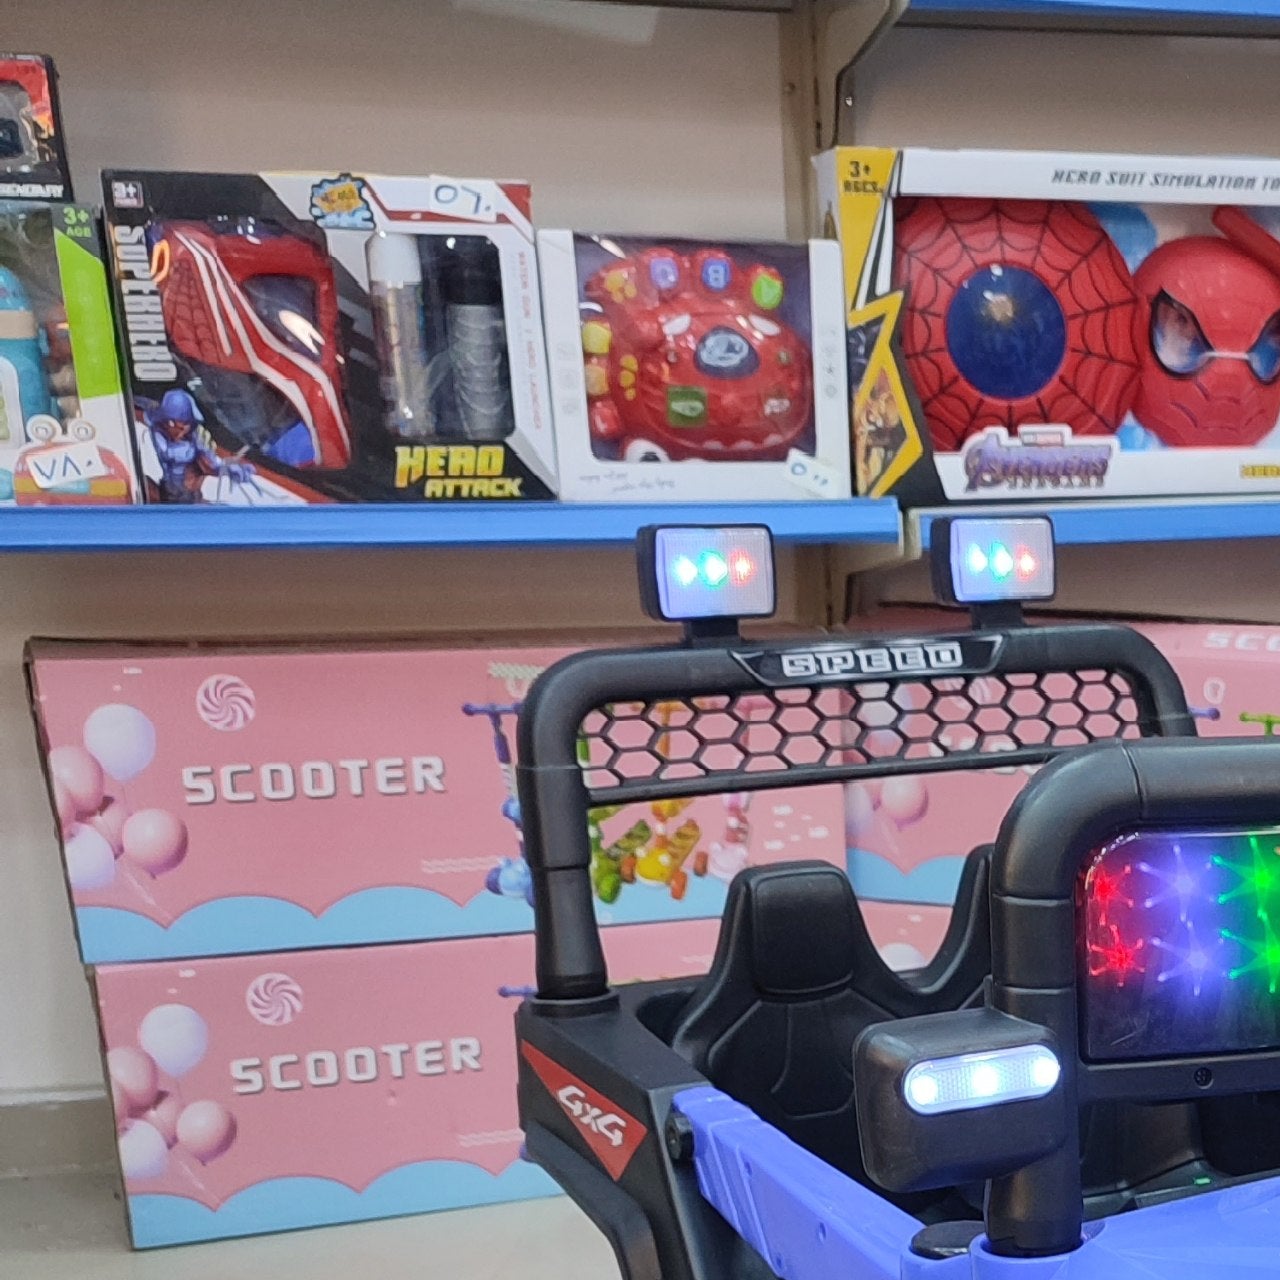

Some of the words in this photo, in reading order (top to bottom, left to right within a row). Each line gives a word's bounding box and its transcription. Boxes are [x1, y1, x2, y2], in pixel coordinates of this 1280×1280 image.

[1105, 171, 1147, 187] SUIT
[62, 207, 90, 225] 3+
[424, 477, 523, 498] ATTACK
[780, 640, 964, 678] SPEED
[181, 755, 448, 806] SCOOTER
[231, 1036, 483, 1095] SCOOTER
